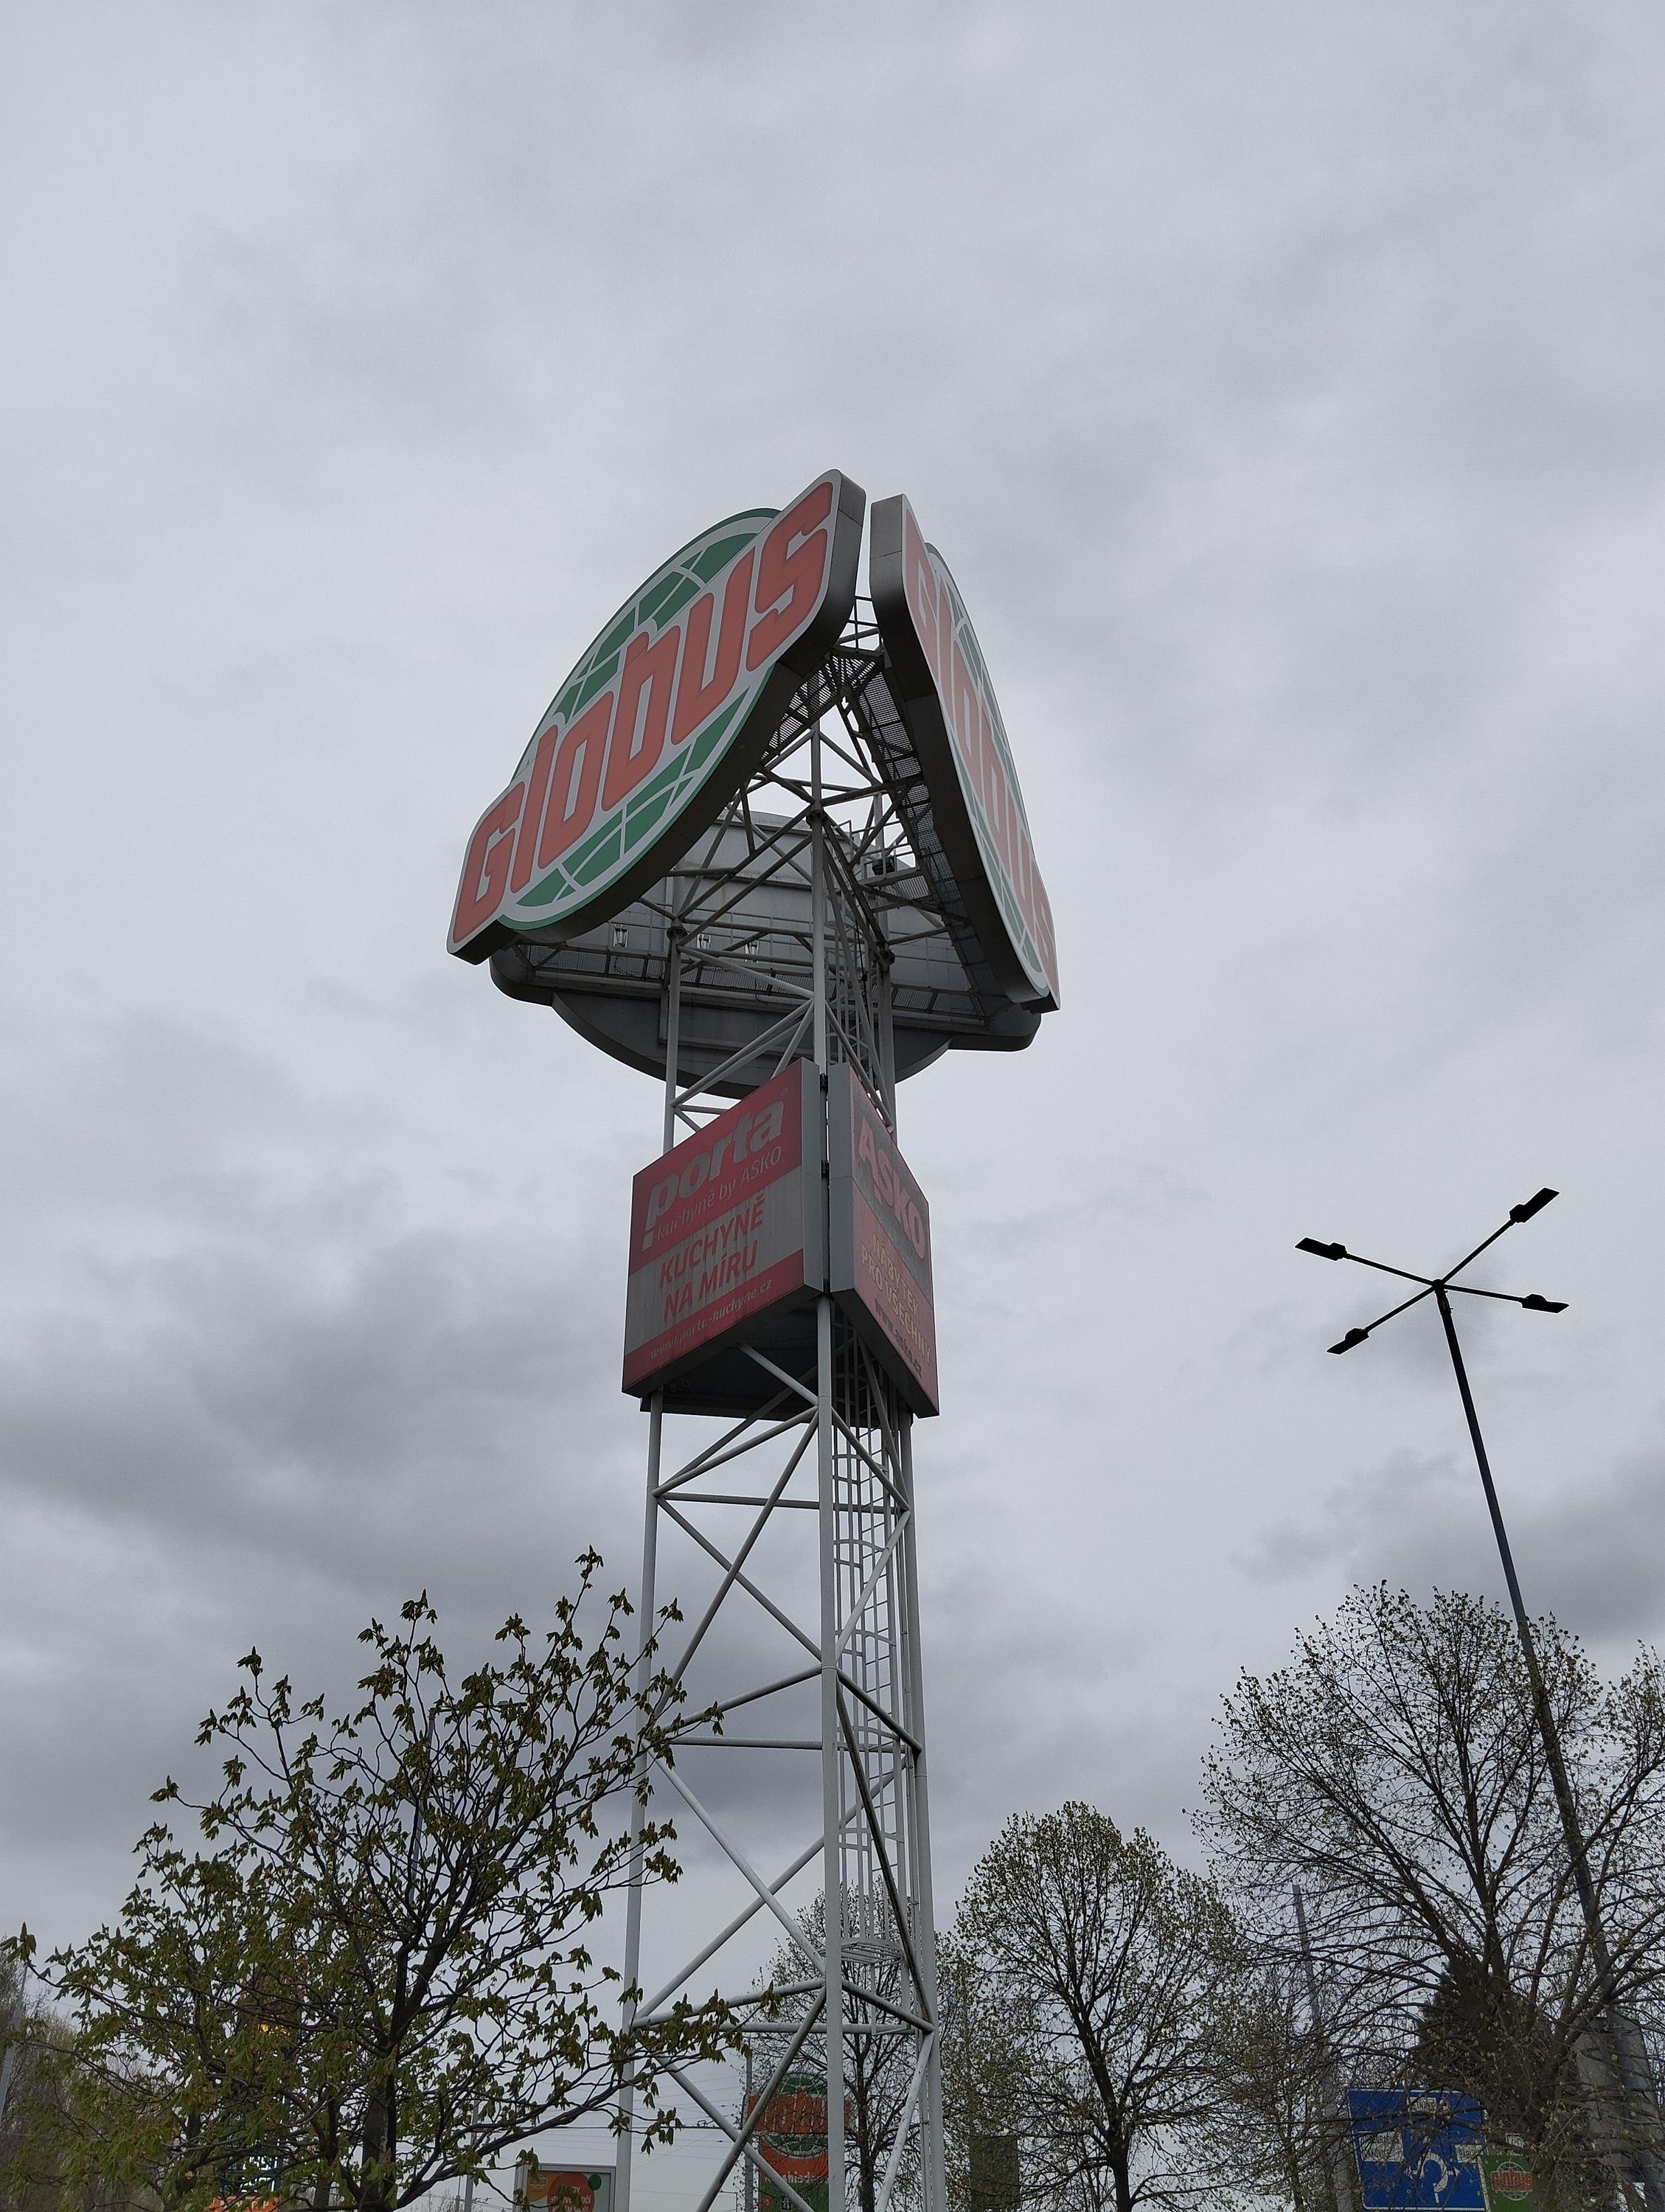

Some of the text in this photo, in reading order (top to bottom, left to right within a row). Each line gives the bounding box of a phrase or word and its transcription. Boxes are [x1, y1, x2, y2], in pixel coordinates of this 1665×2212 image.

[642, 1100, 784, 1251] porta
[657, 1145, 782, 1241] kuchyně by ASKO
[858, 1117, 925, 1259] ASKO
[660, 1195, 765, 1288] KUCHYNĚ
[664, 1240, 758, 1322] NA MÍRU
[873, 1233, 920, 1320] NÁBYTEK
[650, 1279, 773, 1359] www.porta-kuchyne.cz
[861, 1244, 931, 1365] PRO VŠECHNY
